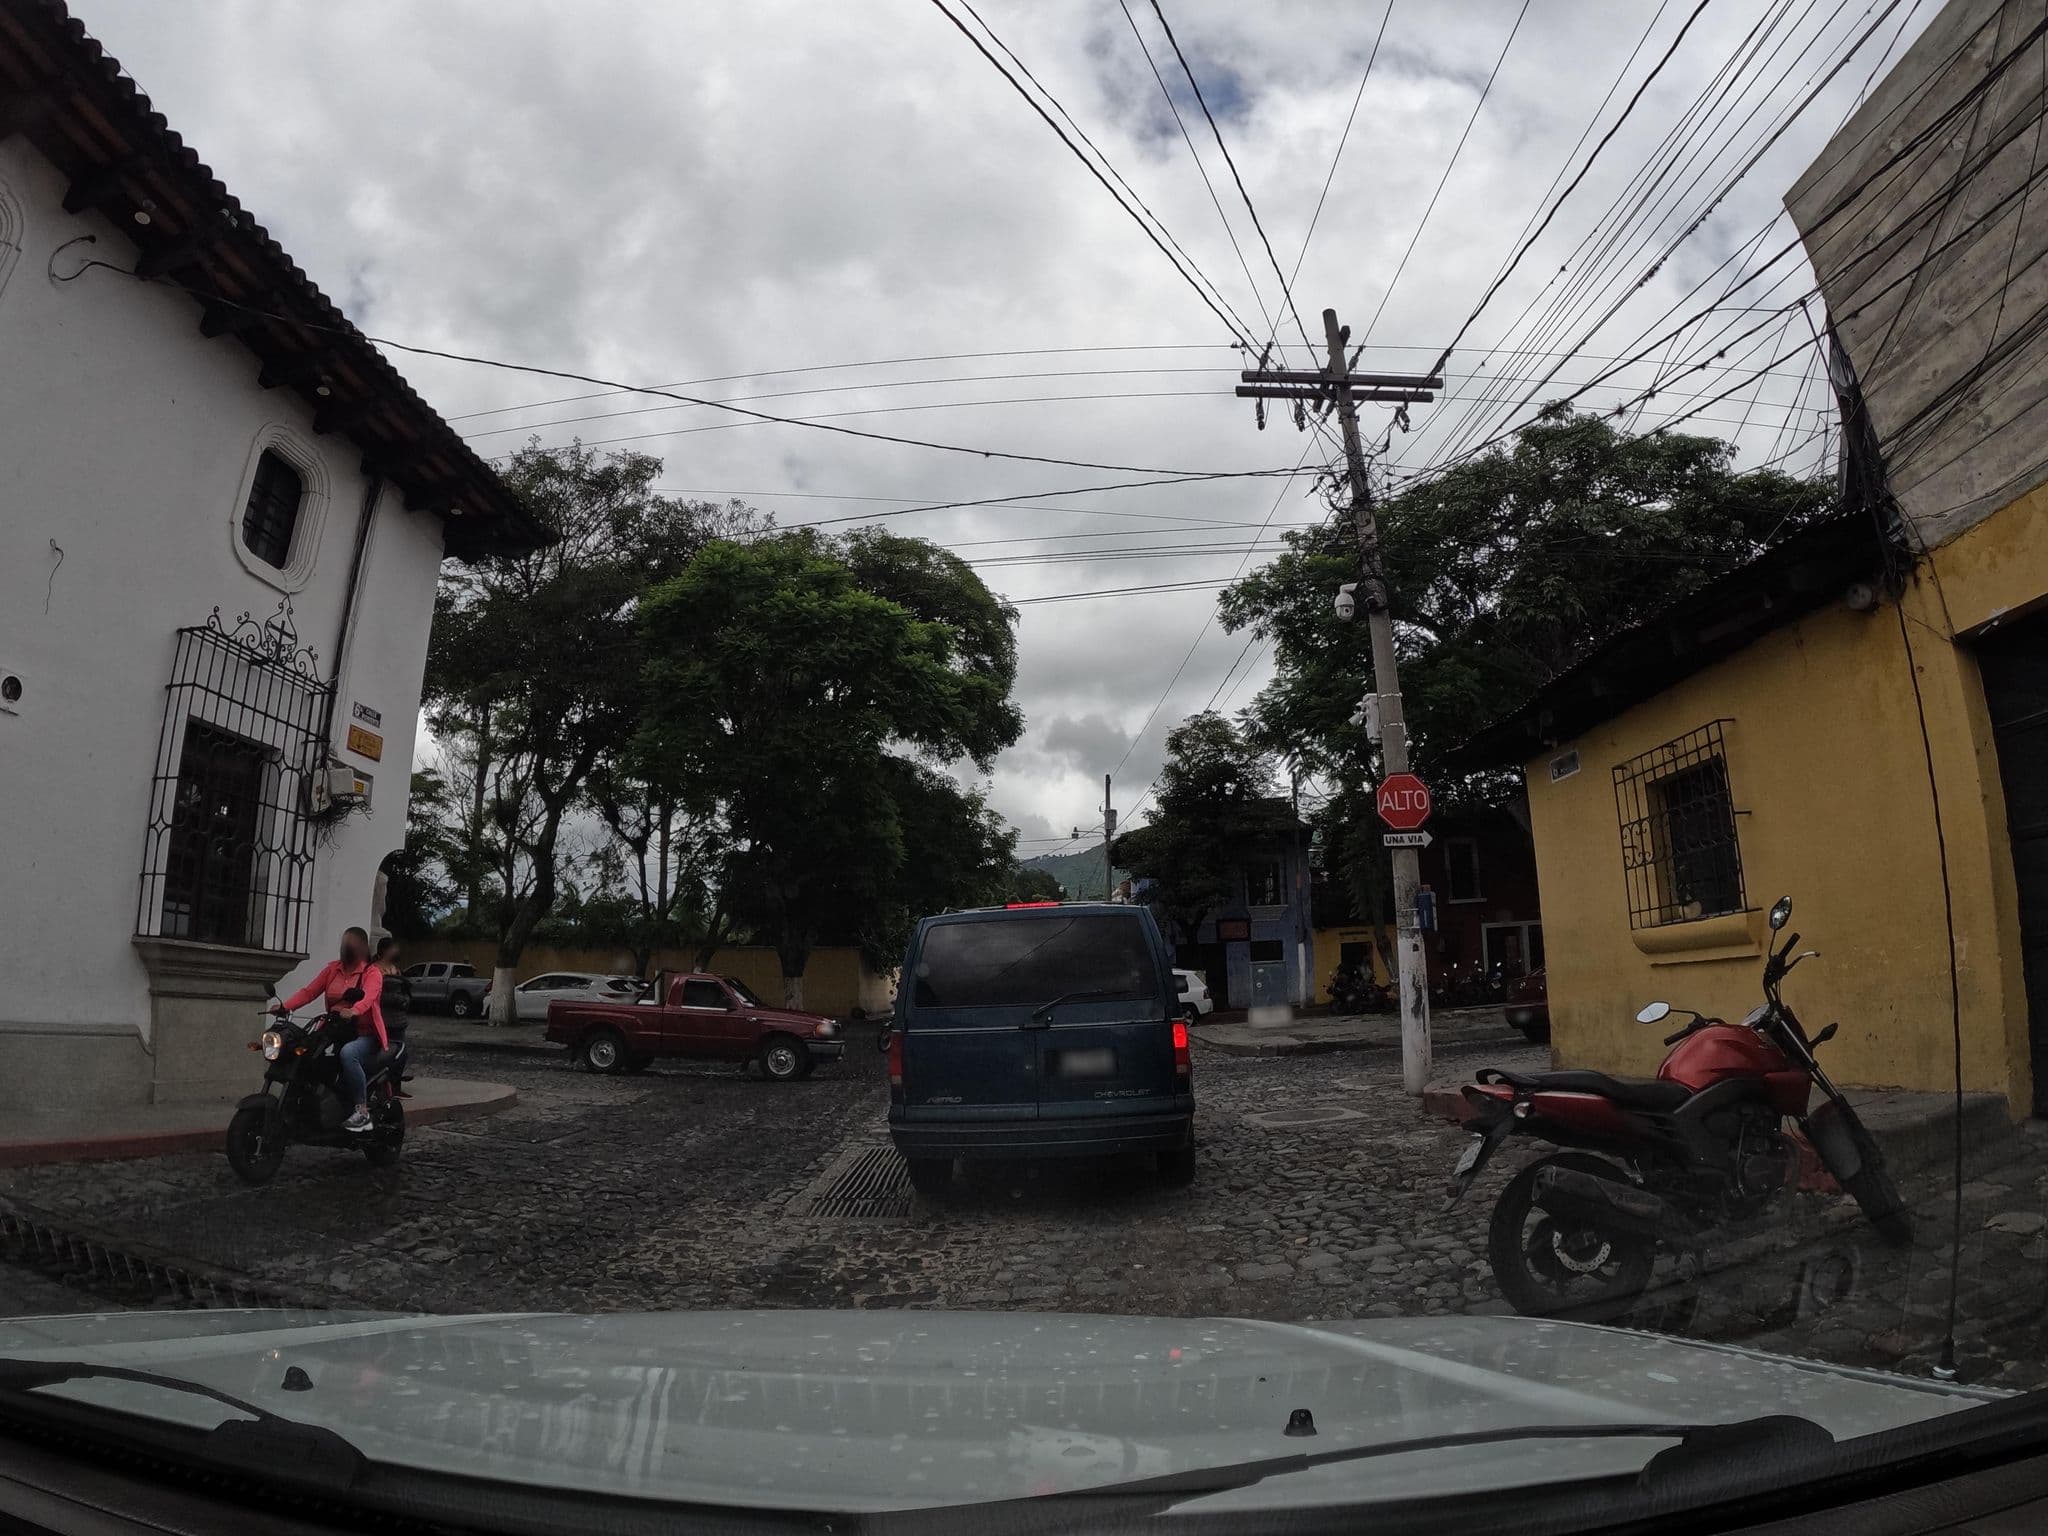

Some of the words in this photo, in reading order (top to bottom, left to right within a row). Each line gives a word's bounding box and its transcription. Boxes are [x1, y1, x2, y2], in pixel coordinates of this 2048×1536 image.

[1381, 790, 1427, 812] ALTO
[1385, 835, 1405, 844] UNA
[1408, 835, 1425, 843] VIA
[1094, 1088, 1152, 1099] CHEVROLET
